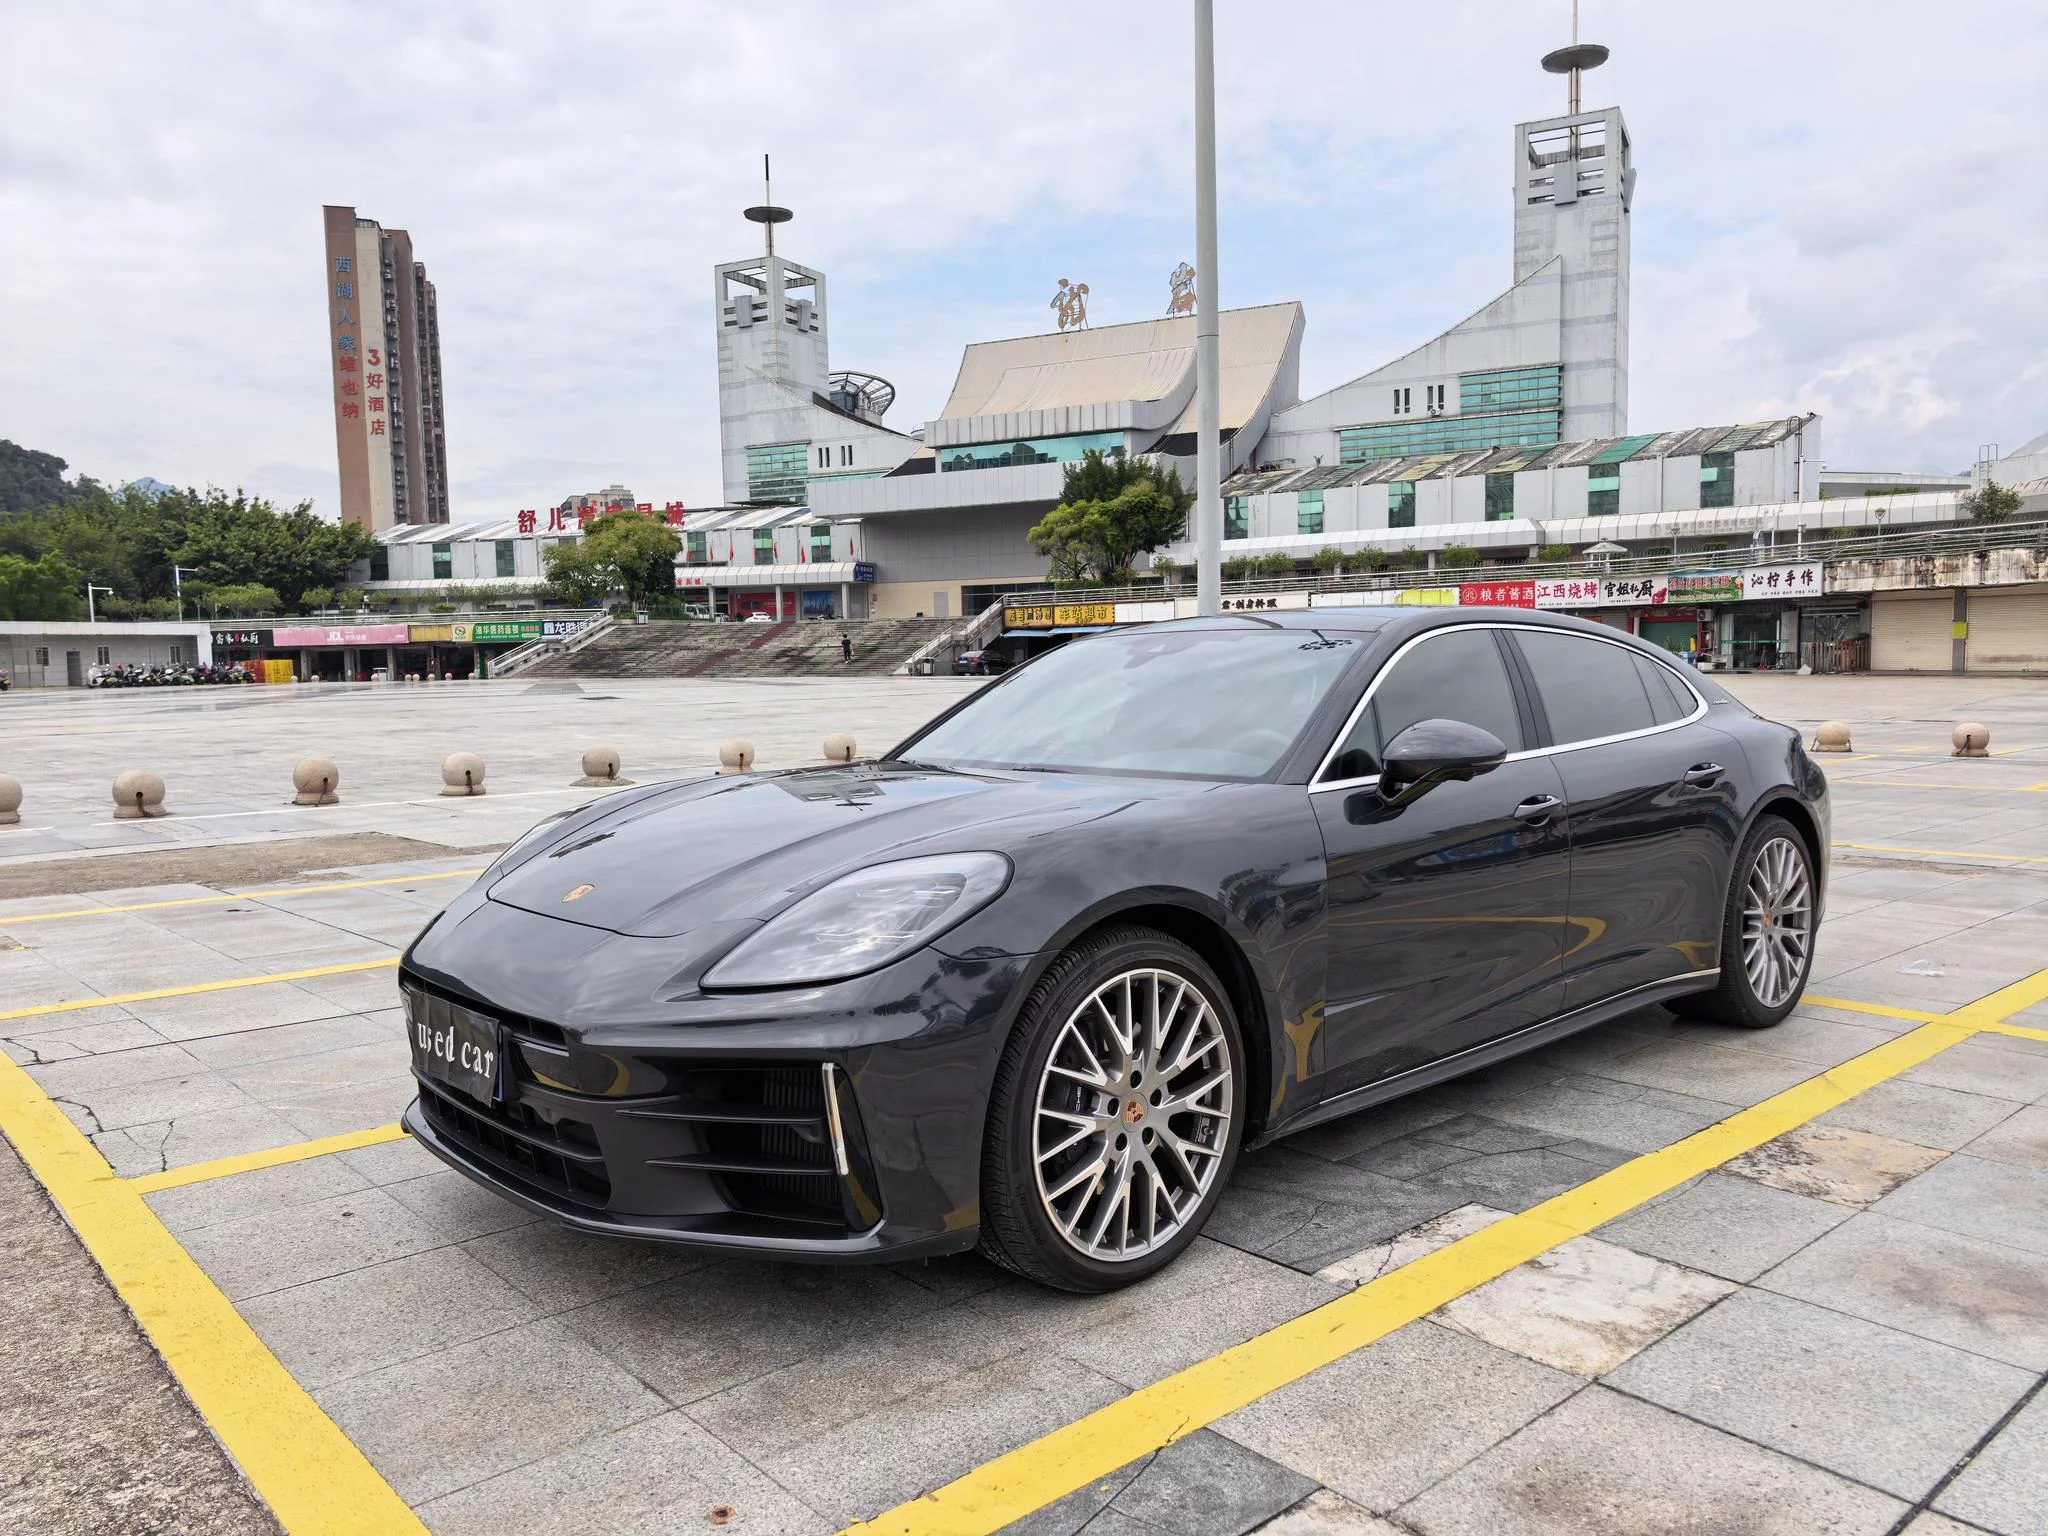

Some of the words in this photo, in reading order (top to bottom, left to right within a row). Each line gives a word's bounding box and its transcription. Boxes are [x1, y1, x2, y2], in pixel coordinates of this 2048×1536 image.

[335, 256, 356, 350] 西湖人家
[366, 349, 385, 436] 3好酒店
[1751, 568, 1814, 588] 沁柠手作
[1479, 586, 1534, 602] 粮者酱酒
[1537, 581, 1598, 599] 江西烧烤
[1604, 579, 1655, 599] 官姐私厨
[1059, 605, 1107, 621] 车站超市
[326, 631, 344, 642] JDL
[418, 1023, 455, 1062] used
[461, 1041, 494, 1078] car
